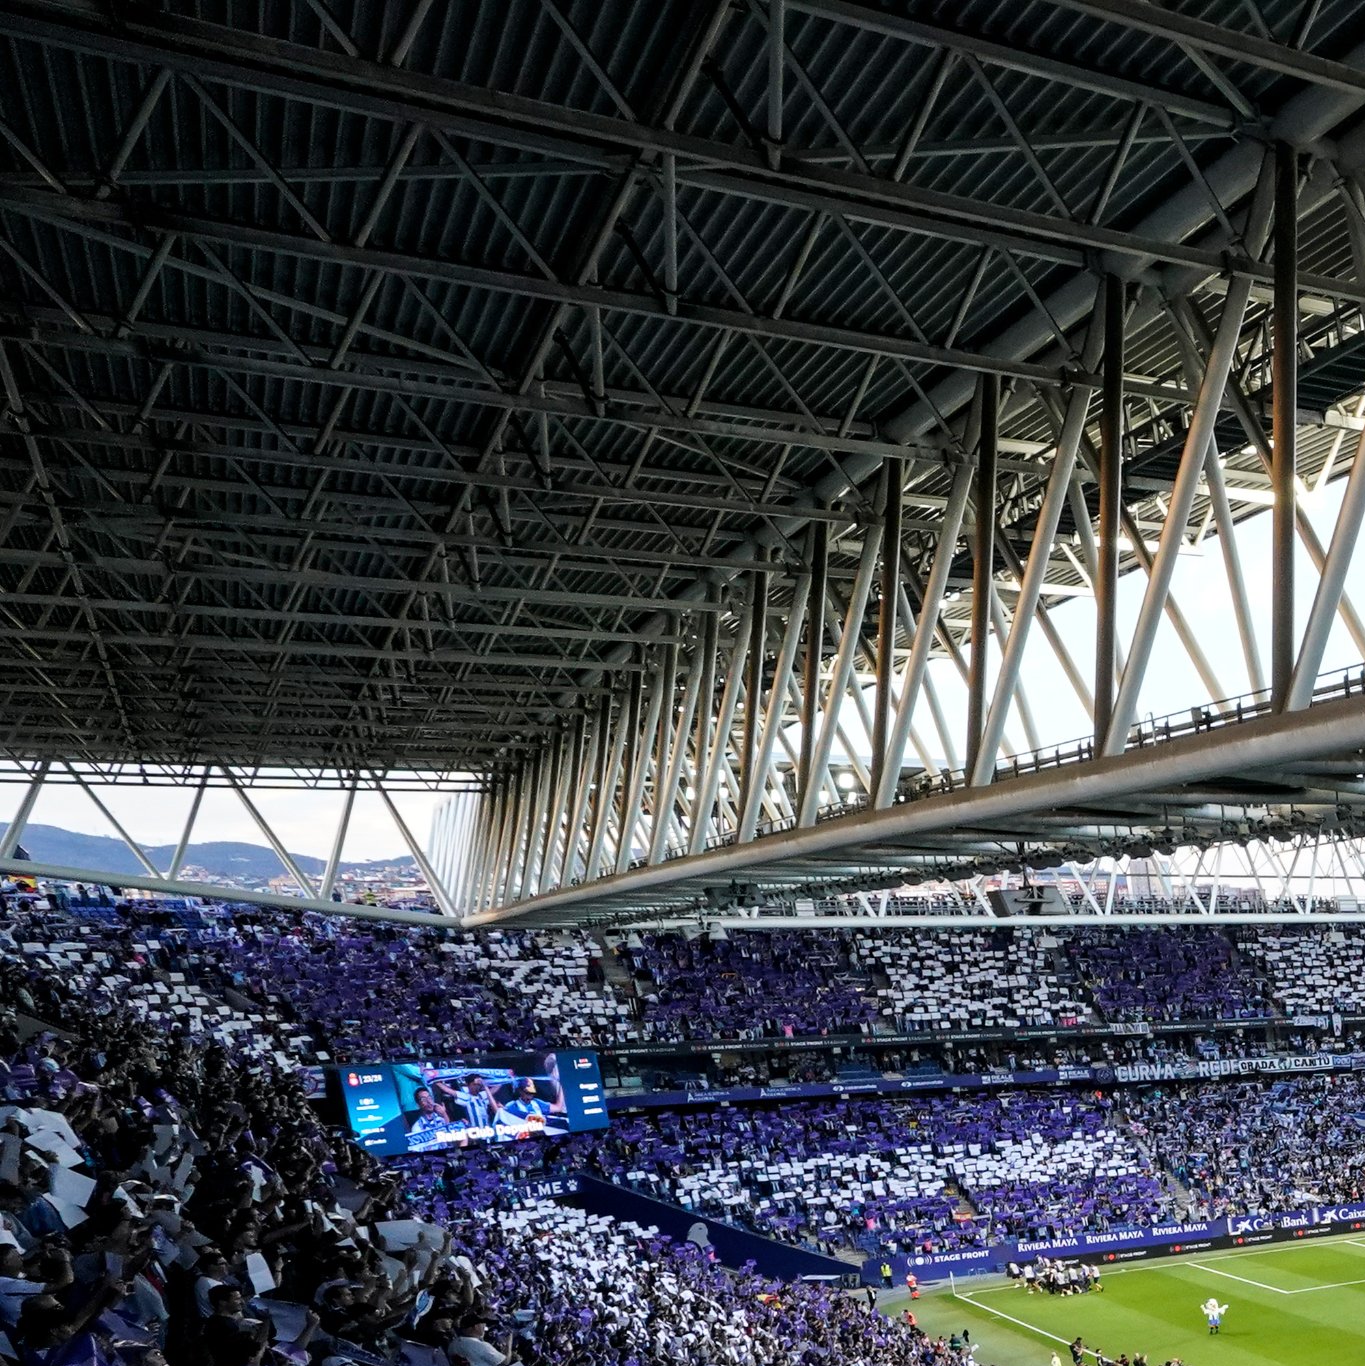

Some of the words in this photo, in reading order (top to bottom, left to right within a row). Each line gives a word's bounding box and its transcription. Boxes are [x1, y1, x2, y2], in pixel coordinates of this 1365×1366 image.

[1241, 1060, 1276, 1070] GRADA
[1117, 1063, 1175, 1082] CURVA
[435, 1127, 461, 1143] Reial
[462, 1124, 494, 1139] Club
[496, 1119, 544, 1136] Deportiu
[1152, 1225, 1182, 1236] RIVIERA
[1183, 1223, 1207, 1233] MAYA
[1018, 1241, 1050, 1252] RIVIERA
[1052, 1238, 1078, 1248] MAYA
[1086, 1234, 1118, 1245] RIVIERA
[1119, 1231, 1144, 1241] MAYA
[934, 1253, 960, 1263] STAGE
[960, 1250, 990, 1260] FRONT
